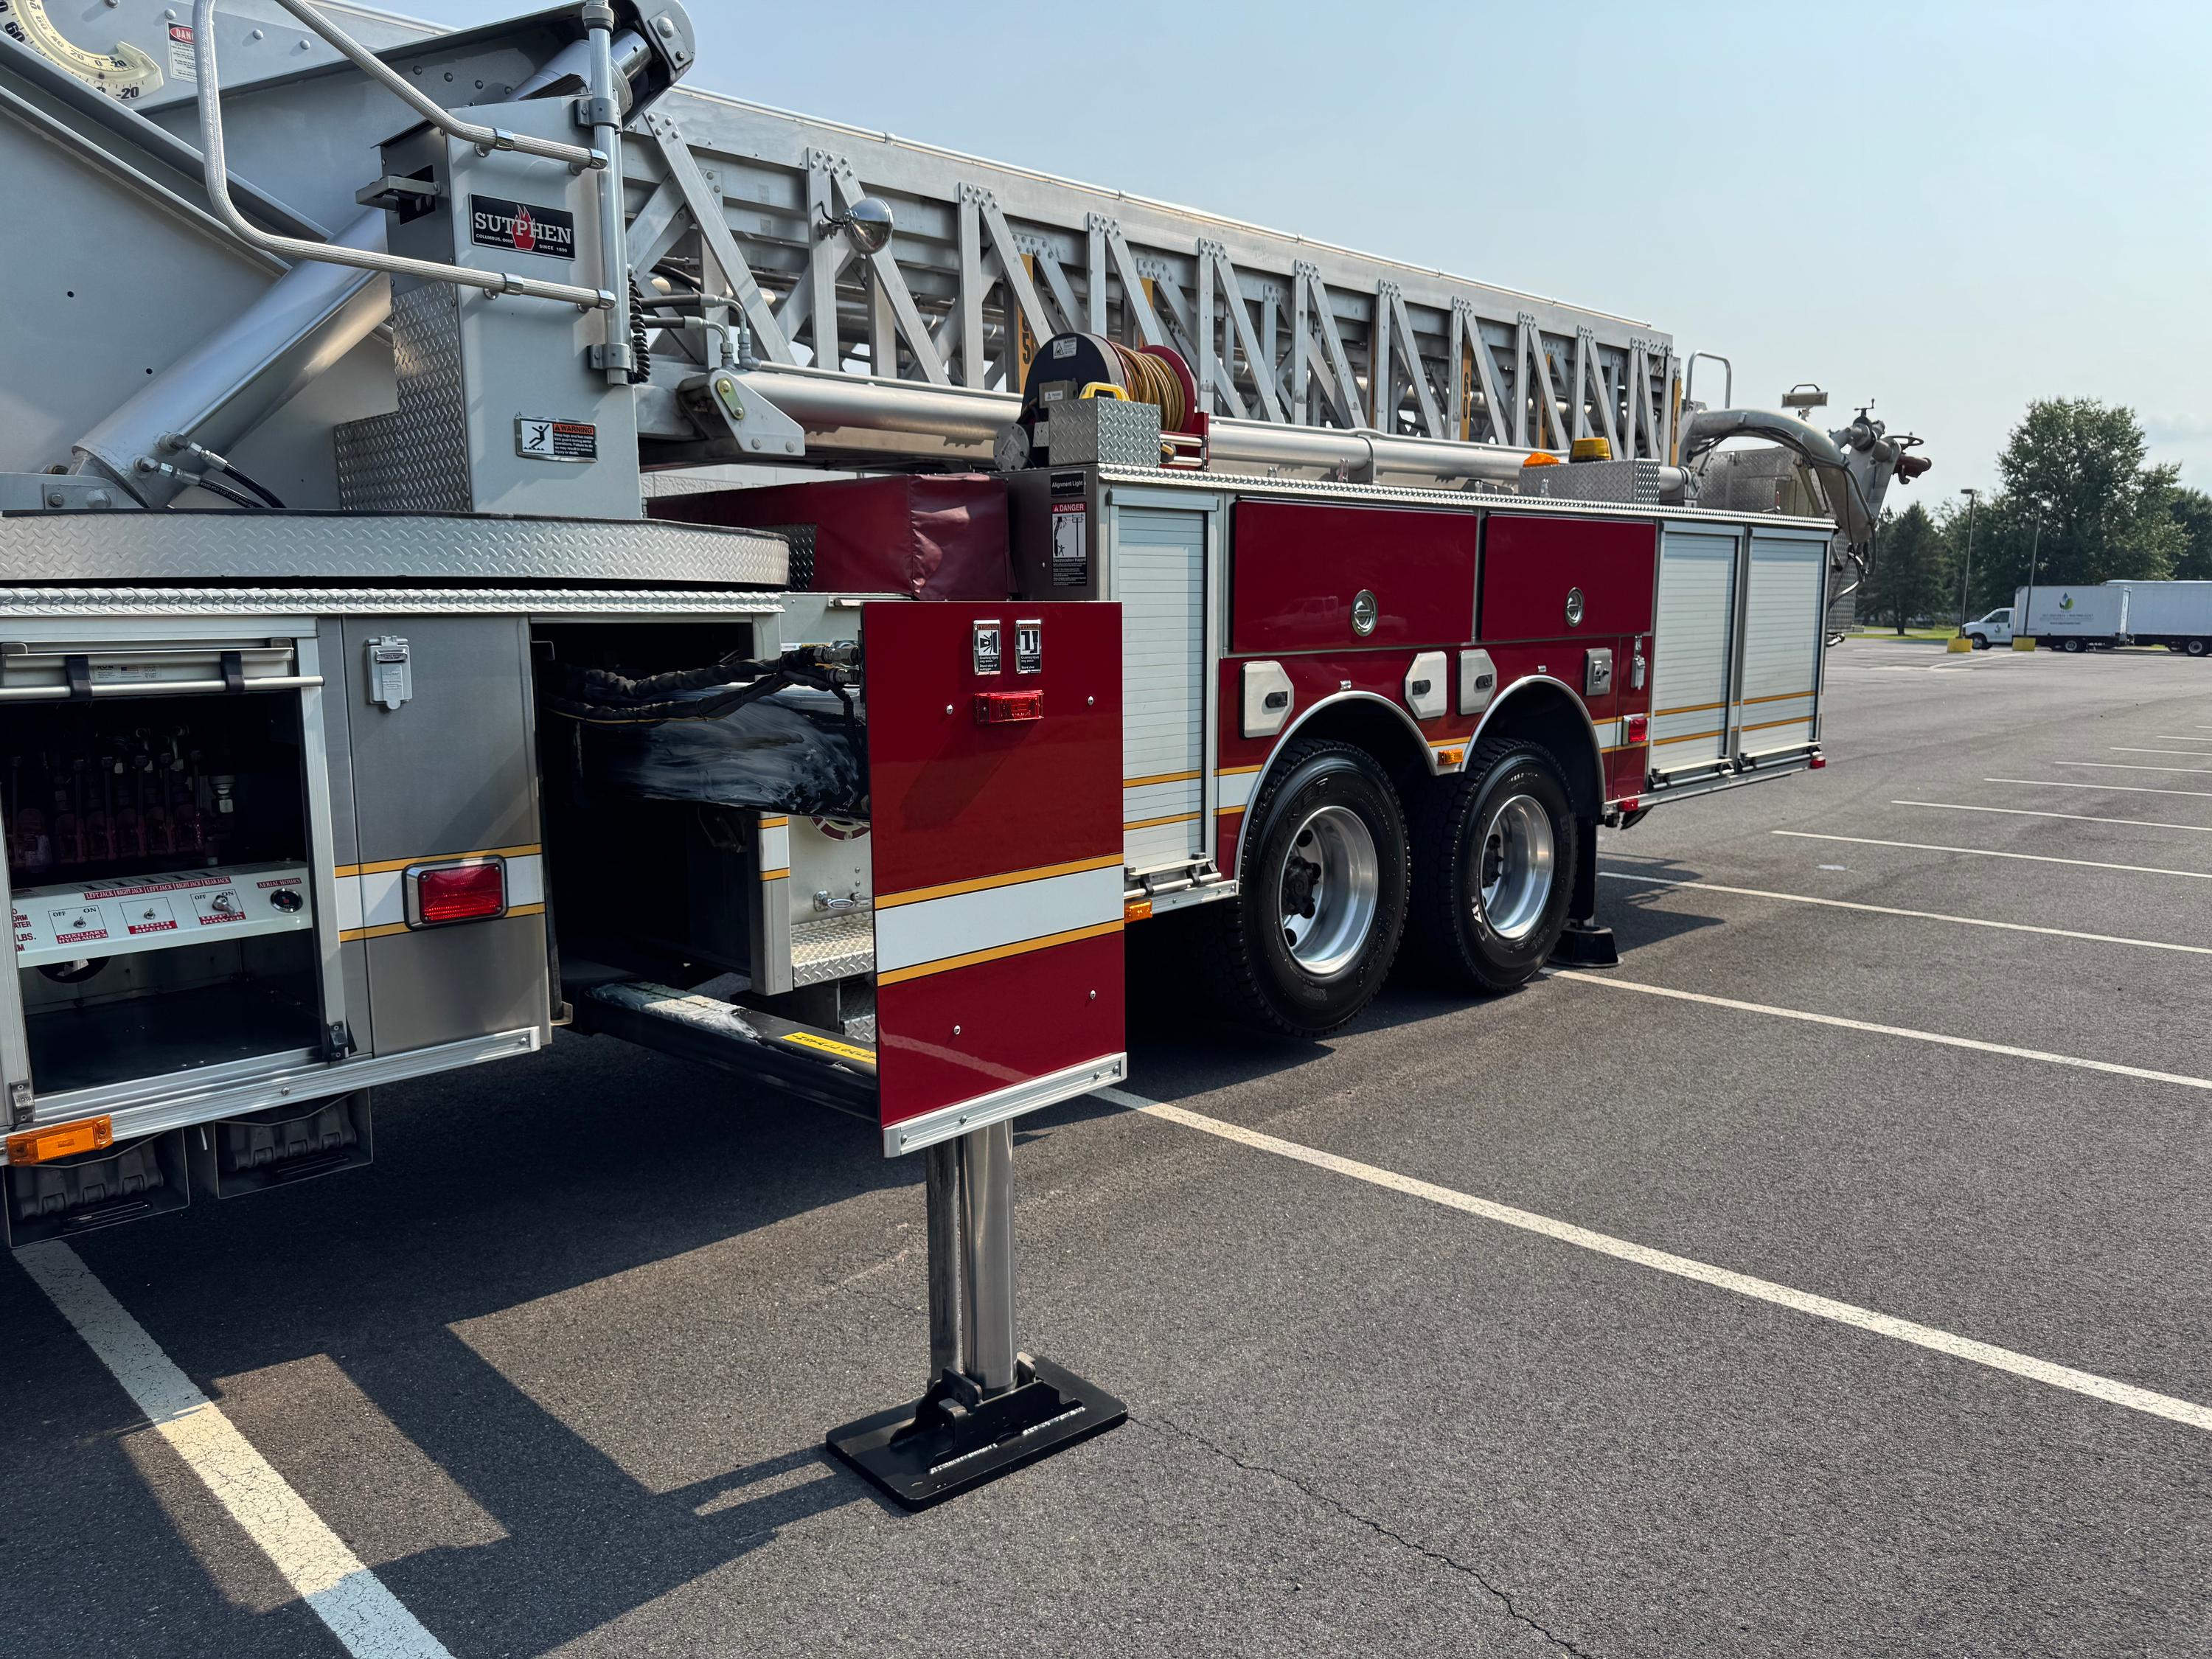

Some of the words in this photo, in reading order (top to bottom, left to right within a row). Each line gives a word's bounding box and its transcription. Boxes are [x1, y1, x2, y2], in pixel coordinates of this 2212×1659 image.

[175, 28, 194, 41] DAN
[51, 36, 64, 48] 40
[70, 50, 84, 61] 20
[110, 60, 127, 68] -20
[116, 86, 139, 99] -20
[475, 212, 571, 244] SUTPHEN
[476, 234, 501, 243] COLUMBUS,
[1463, 372, 1469, 419] 60
[560, 425, 592, 434] WARNING
[1051, 481, 1072, 490] Alignment
[1072, 480, 1083, 488] Light
[1059, 504, 1084, 512] DANGER
[135, 921, 170, 929] HIGH
[203, 916, 243, 925] POWER
[135, 925, 173, 933] SPEED
[16, 933, 36, 942] LBS.
[58, 933, 108, 944] HYDRAULICS
[59, 930, 106, 940] AUXILIARY
